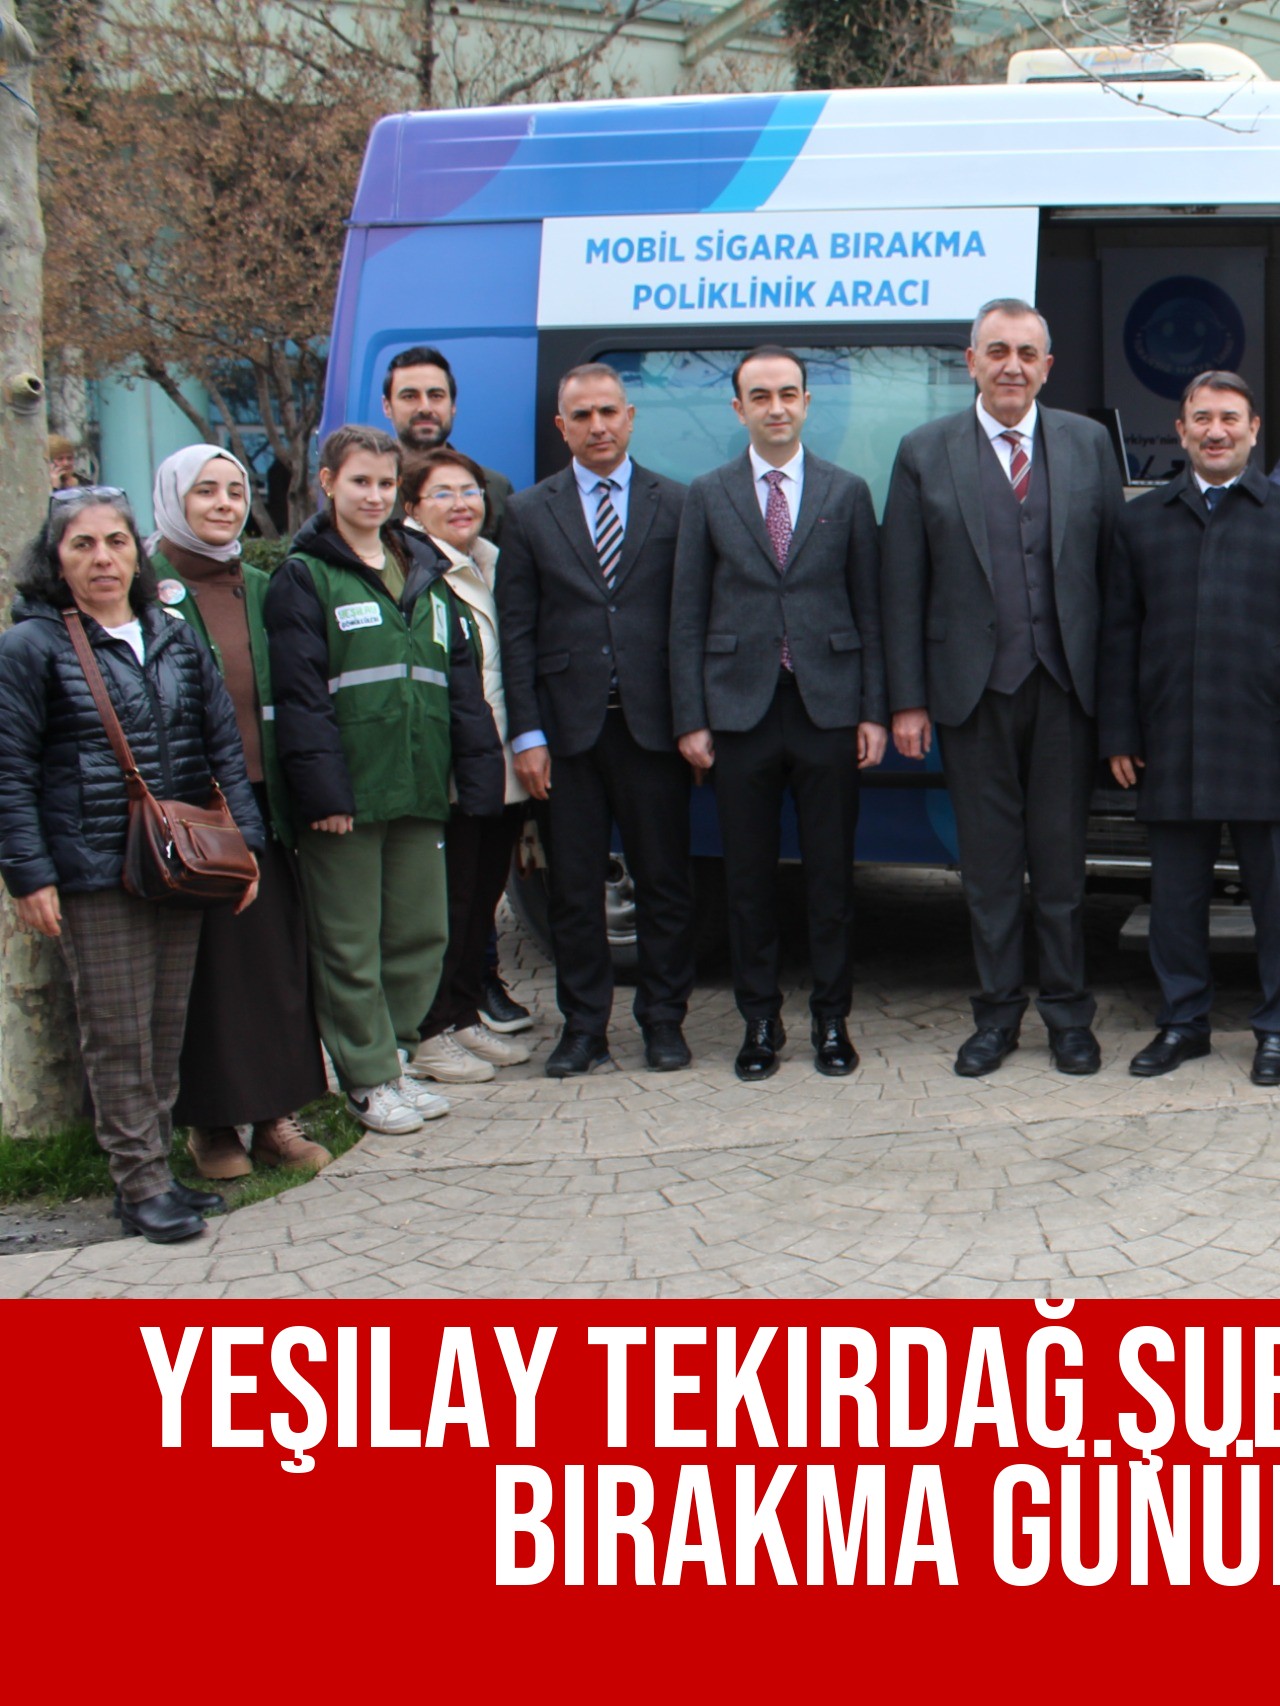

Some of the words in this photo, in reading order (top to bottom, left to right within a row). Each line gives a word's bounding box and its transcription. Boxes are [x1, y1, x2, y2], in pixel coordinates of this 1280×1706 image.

[585, 230, 686, 265] MOBİL
[695, 229, 820, 262] SİGARA
[829, 230, 987, 259] BIRAKMA
[632, 275, 817, 311] POLİKLİNİK
[825, 279, 930, 308] ARACI
